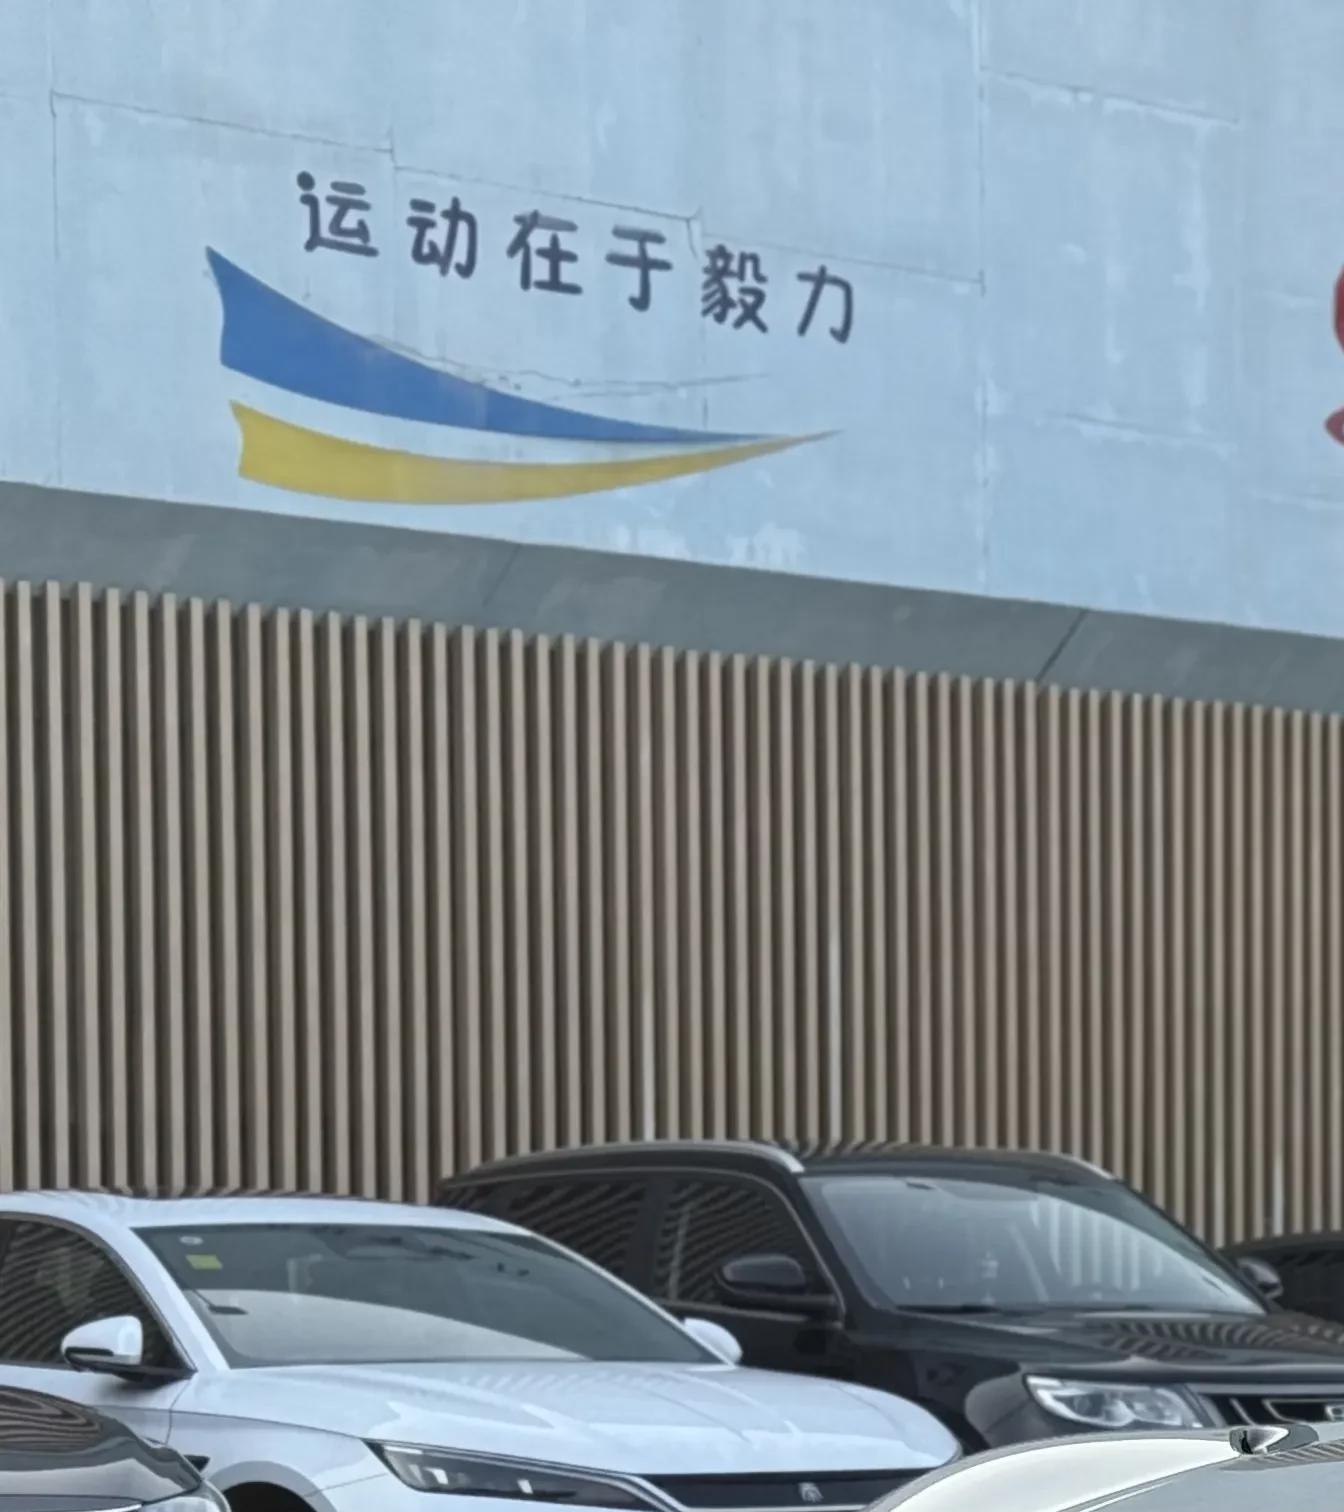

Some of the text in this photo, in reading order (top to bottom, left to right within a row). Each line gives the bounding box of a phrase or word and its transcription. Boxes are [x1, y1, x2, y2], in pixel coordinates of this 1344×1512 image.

[296, 170, 854, 344] 运动在于毅力
